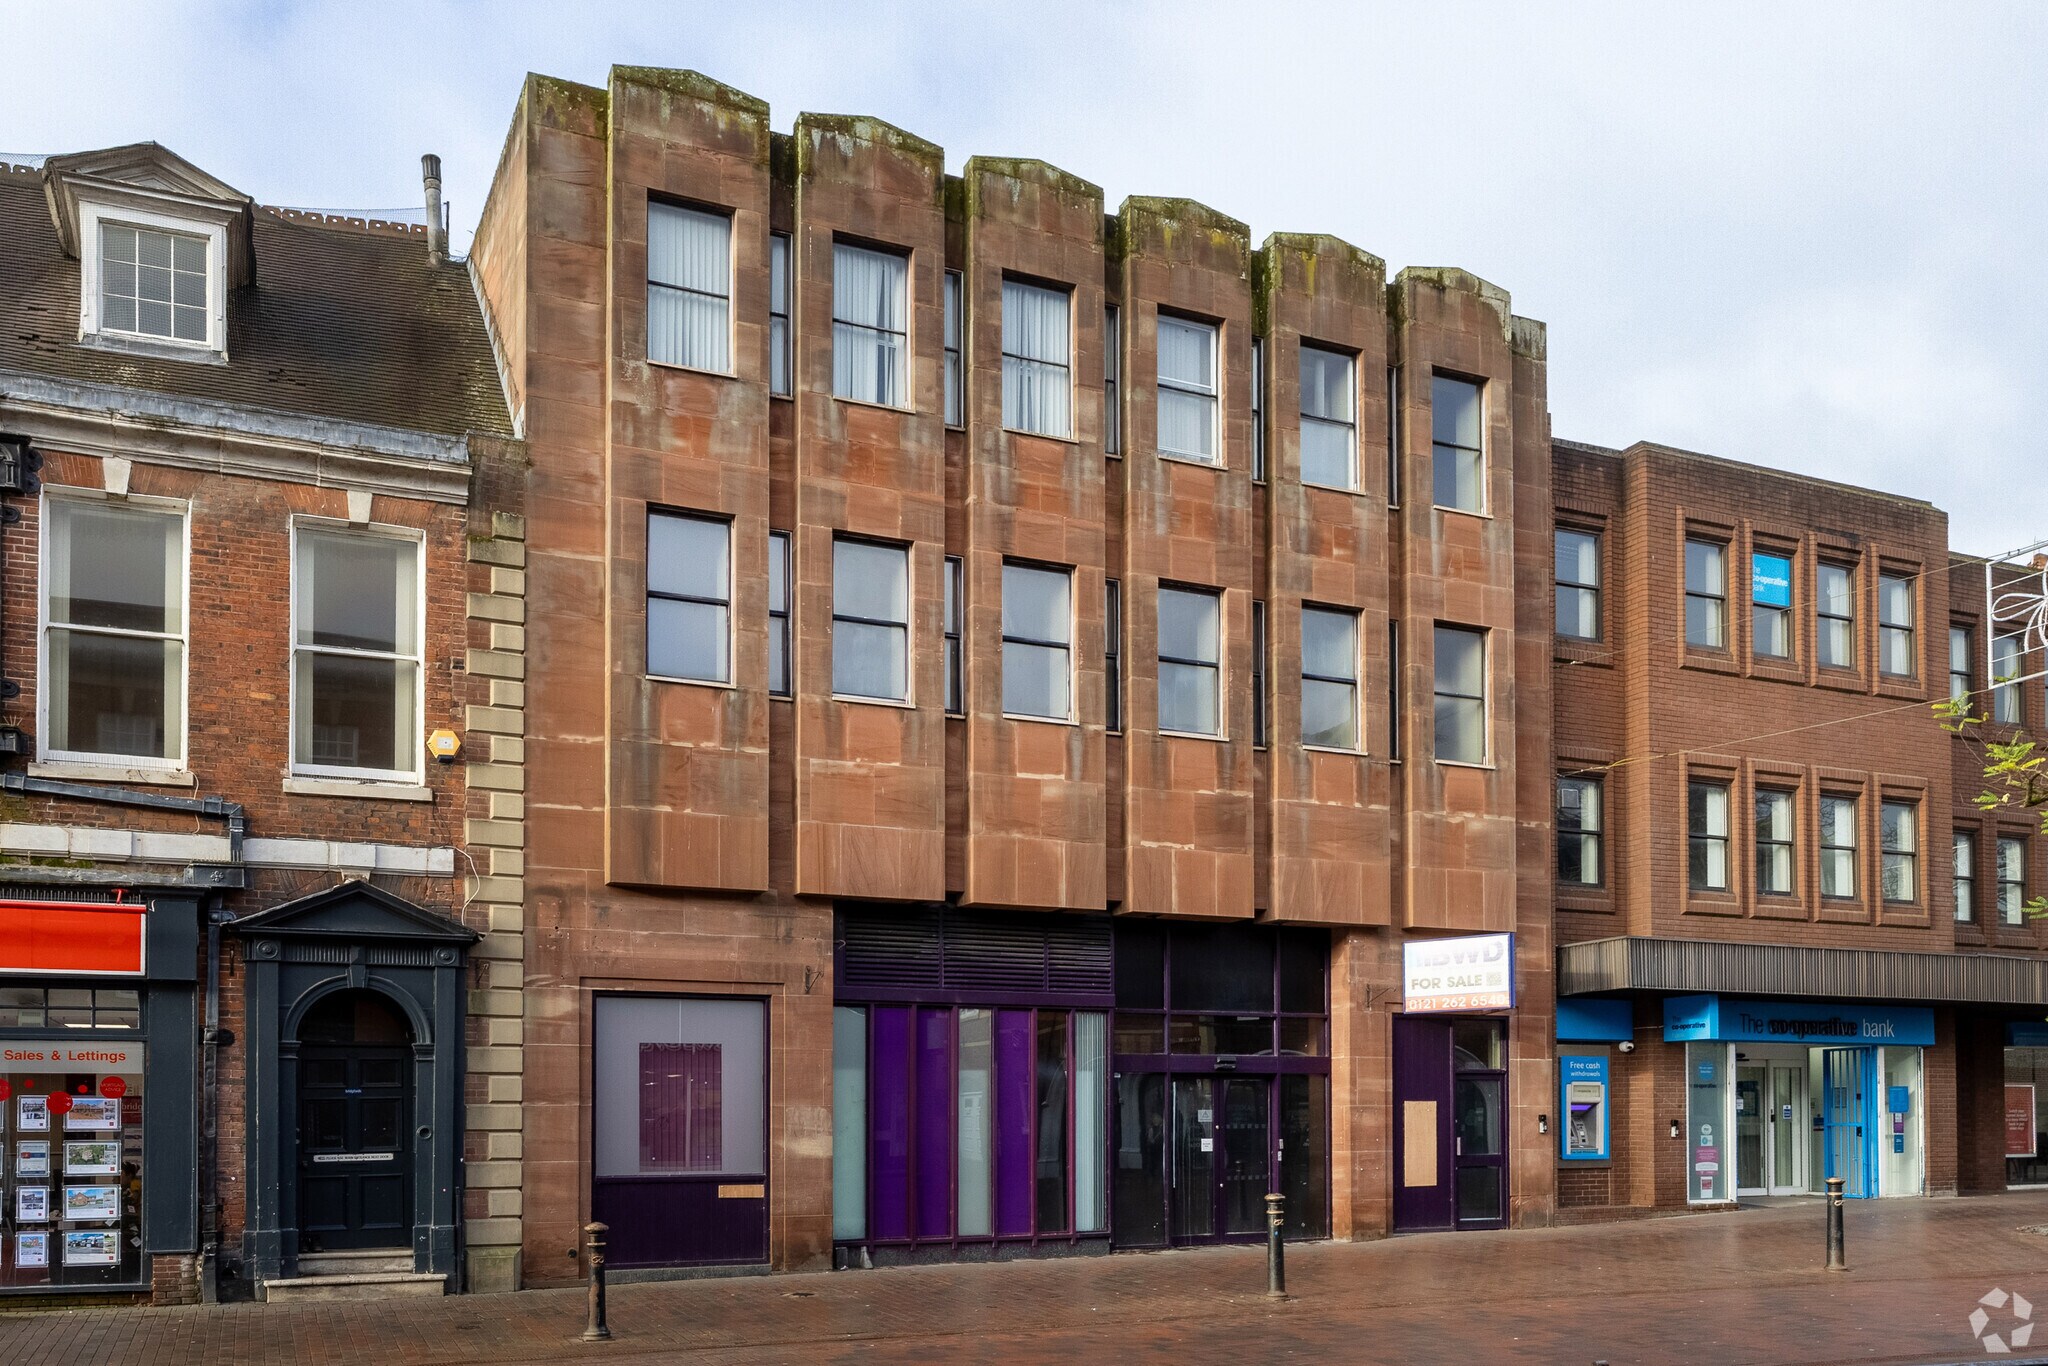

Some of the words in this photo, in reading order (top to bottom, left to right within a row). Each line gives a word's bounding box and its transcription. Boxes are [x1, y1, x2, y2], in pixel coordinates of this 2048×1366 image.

[1411, 978, 1441, 990] FOR
[1446, 974, 1482, 988] SALE
[1409, 999, 1437, 1010] 0121
[1442, 996, 1467, 1009] 262
[1470, 994, 1506, 1007] 6540
[1671, 1021, 1706, 1031] co-operative
[1739, 1013, 1764, 1034] The
[1862, 1018, 1895, 1038] bank
[4, 1049, 44, 1061] Sales
[50, 1050, 61, 1061] &
[68, 1050, 126, 1063] Lettings
[1570, 1061, 1584, 1069] Free
[1585, 1061, 1600, 1069] cash
